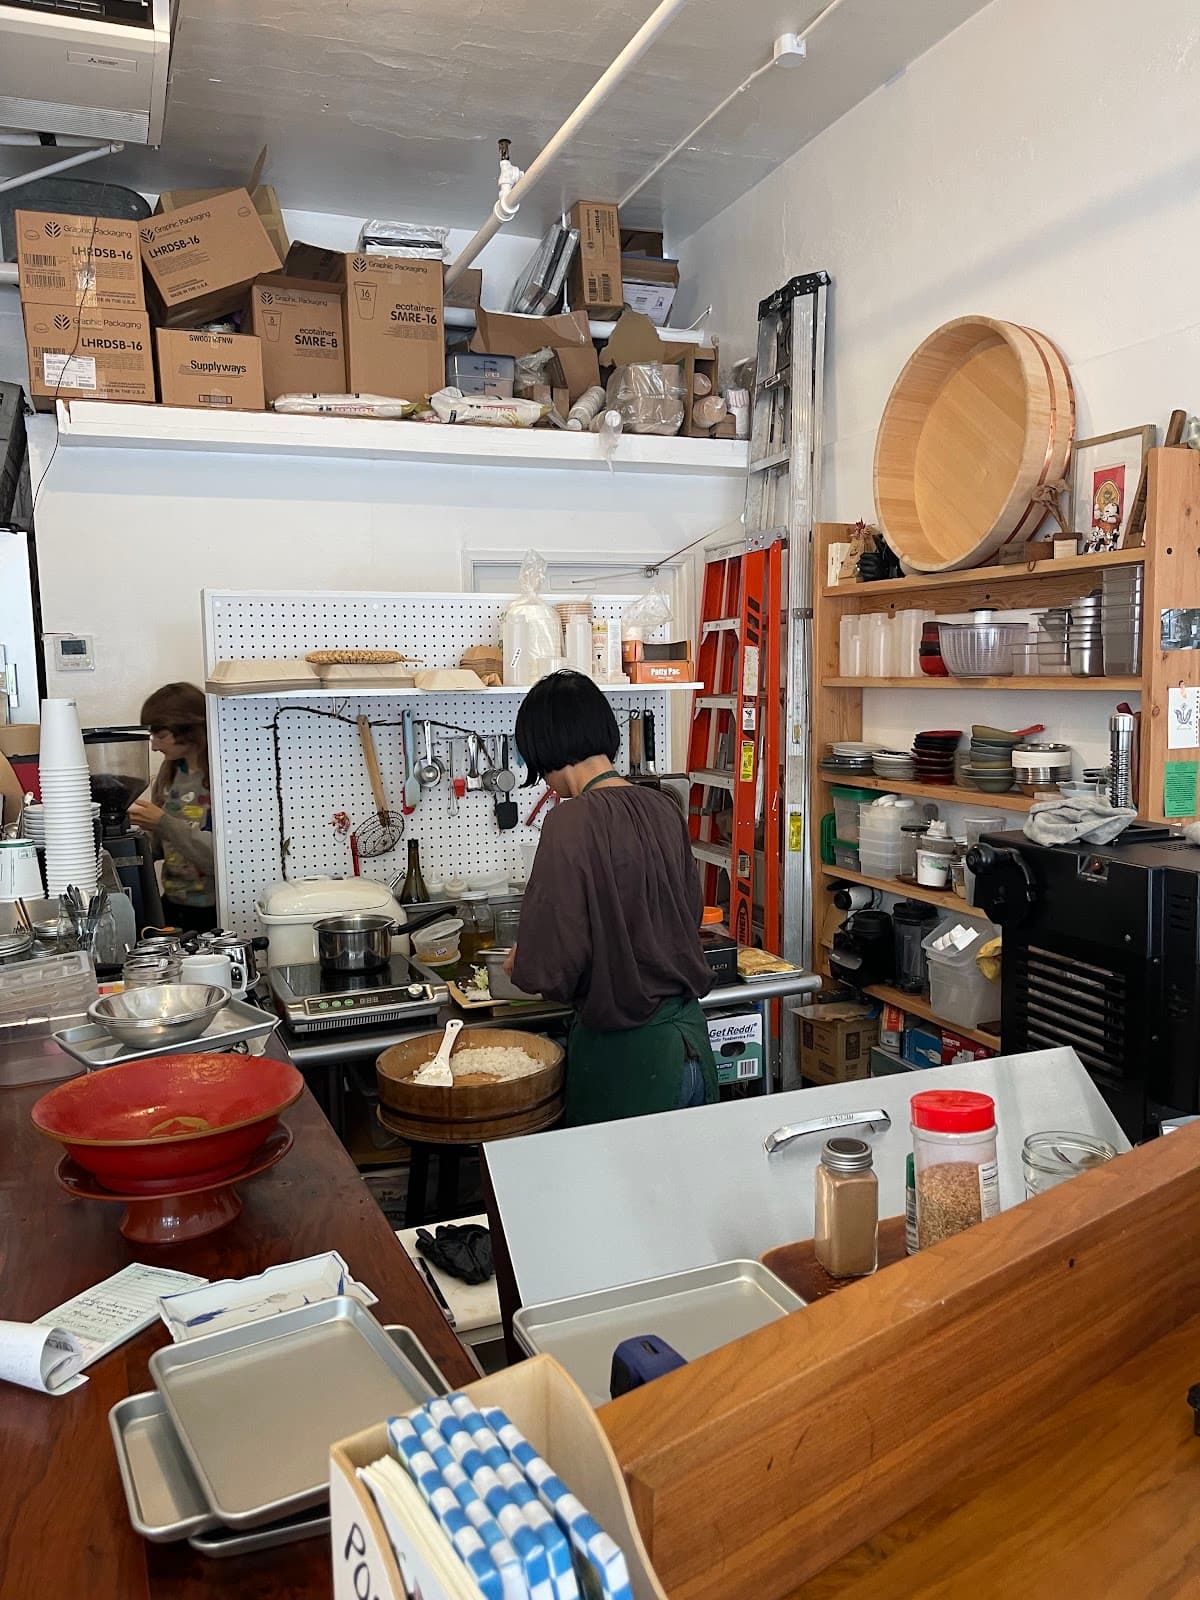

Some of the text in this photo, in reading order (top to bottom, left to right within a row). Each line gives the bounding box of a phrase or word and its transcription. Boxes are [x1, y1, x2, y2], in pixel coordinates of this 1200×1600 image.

[154, 211, 211, 233] Graphic Packaging
[94, 228, 132, 239] Packaging
[71, 246, 133, 260] LHRDSB-16
[148, 235, 200, 259] LHRDSB-16
[368, 261, 428, 273] Graphic Packaging
[361, 289, 370, 298] 16
[395, 303, 438, 313] ecotainer
[72, 317, 142, 329] Graphic Packaging
[390, 310, 437, 325] SMRE-16
[299, 327, 336, 337] ecotainer
[81, 338, 143, 351] LHRDSB-16
[294, 334, 338, 348] SMRE-8
[190, 359, 247, 374] Supplyways
[650, 667, 667, 676] Patty
